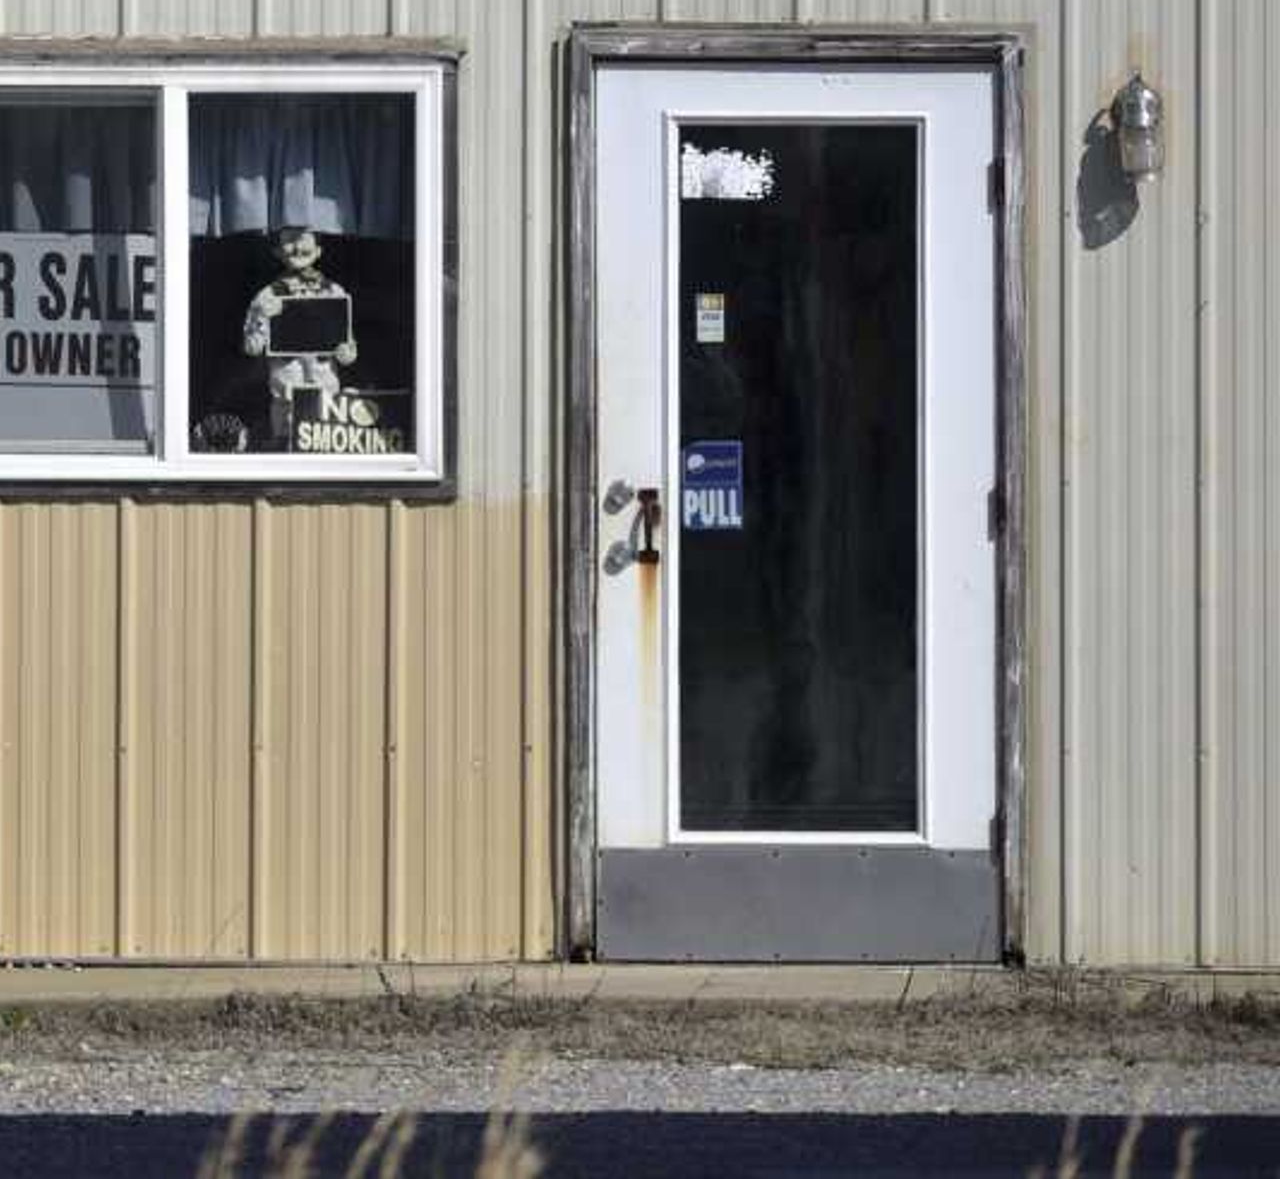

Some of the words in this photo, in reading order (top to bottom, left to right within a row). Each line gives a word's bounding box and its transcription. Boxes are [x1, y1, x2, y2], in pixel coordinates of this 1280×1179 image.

[38, 251, 155, 321] SALE
[6, 330, 140, 378] OWNER
[321, 392, 379, 427] NO
[684, 489, 742, 528] PULL
